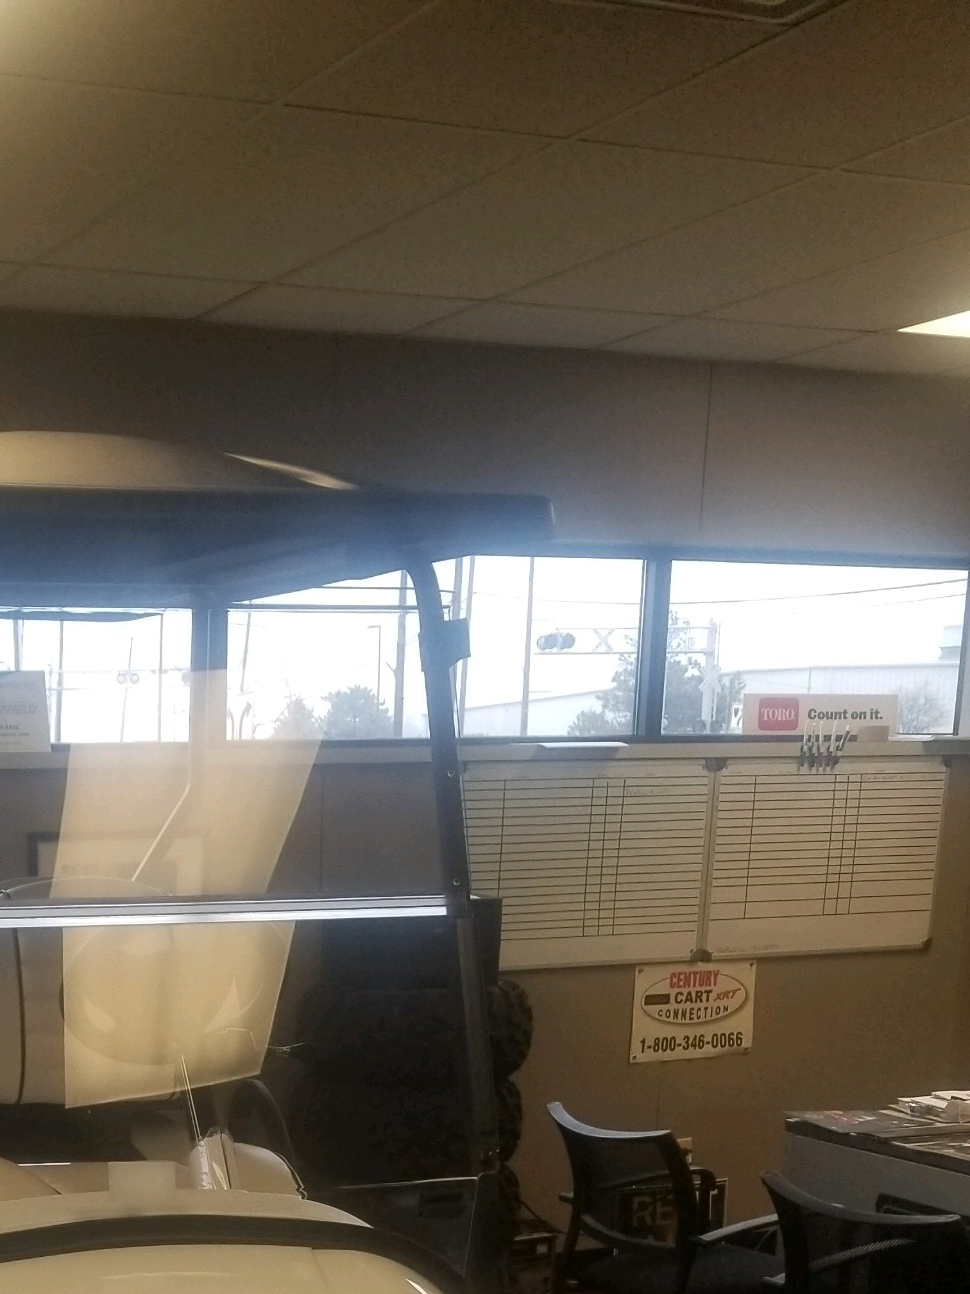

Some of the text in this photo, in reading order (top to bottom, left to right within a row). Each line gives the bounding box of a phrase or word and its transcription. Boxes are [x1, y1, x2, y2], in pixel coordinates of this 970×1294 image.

[761, 707, 795, 721] TORO
[807, 708, 883, 720] Count on it.
[669, 969, 720, 988] CENTURY
[674, 989, 713, 1004] CART
[657, 1004, 729, 1021] CONNECTION
[639, 1031, 743, 1053] 1-800-346-0066
